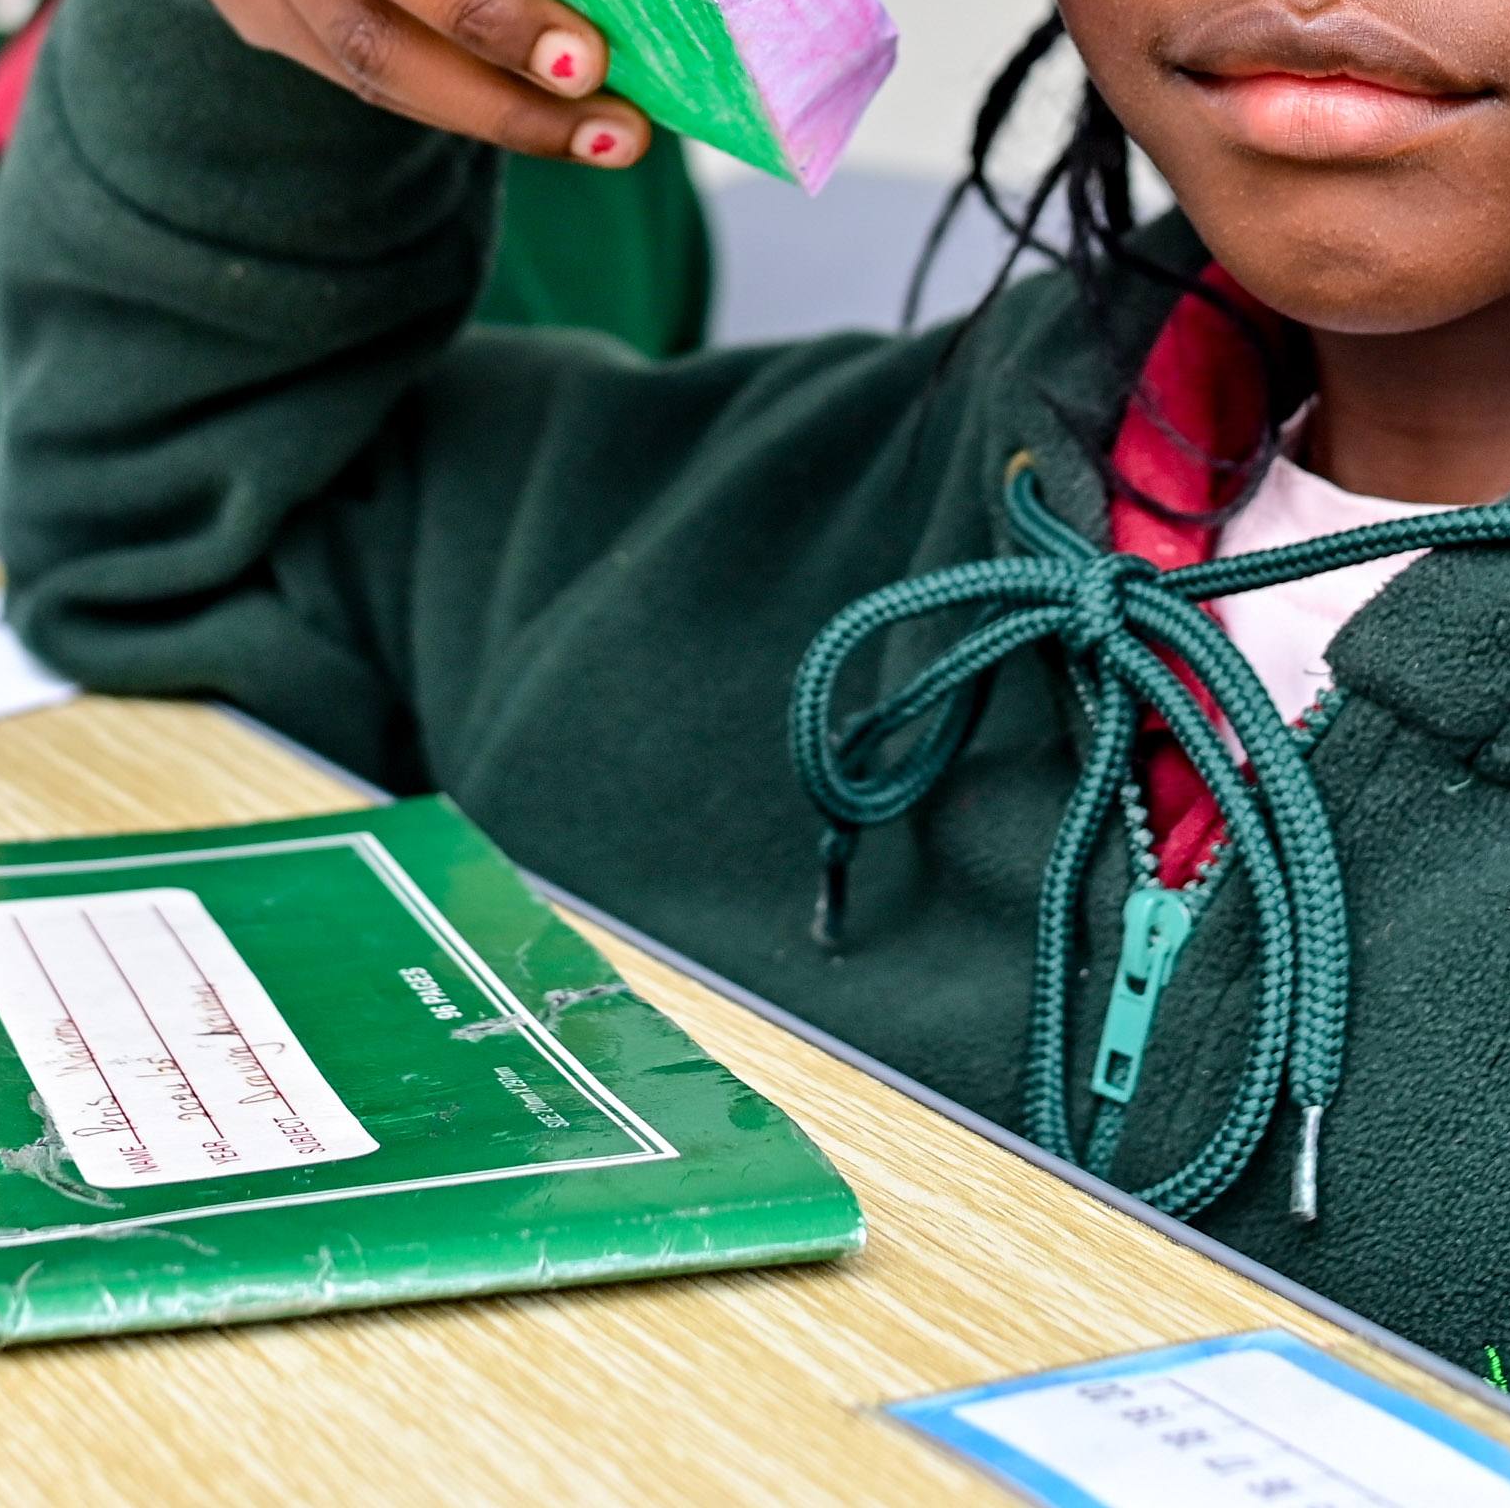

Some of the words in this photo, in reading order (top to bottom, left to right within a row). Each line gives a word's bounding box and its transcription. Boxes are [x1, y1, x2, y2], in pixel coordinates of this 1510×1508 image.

[397, 966, 452, 1005] PAGES
[429, 1004, 463, 1021] 96
[226, 1042, 286, 1105] Drawing
[201, 1139, 242, 1166] YEAR
[273, 1116, 327, 1155] SUBJECT
[118, 1144, 162, 1174] NAME
